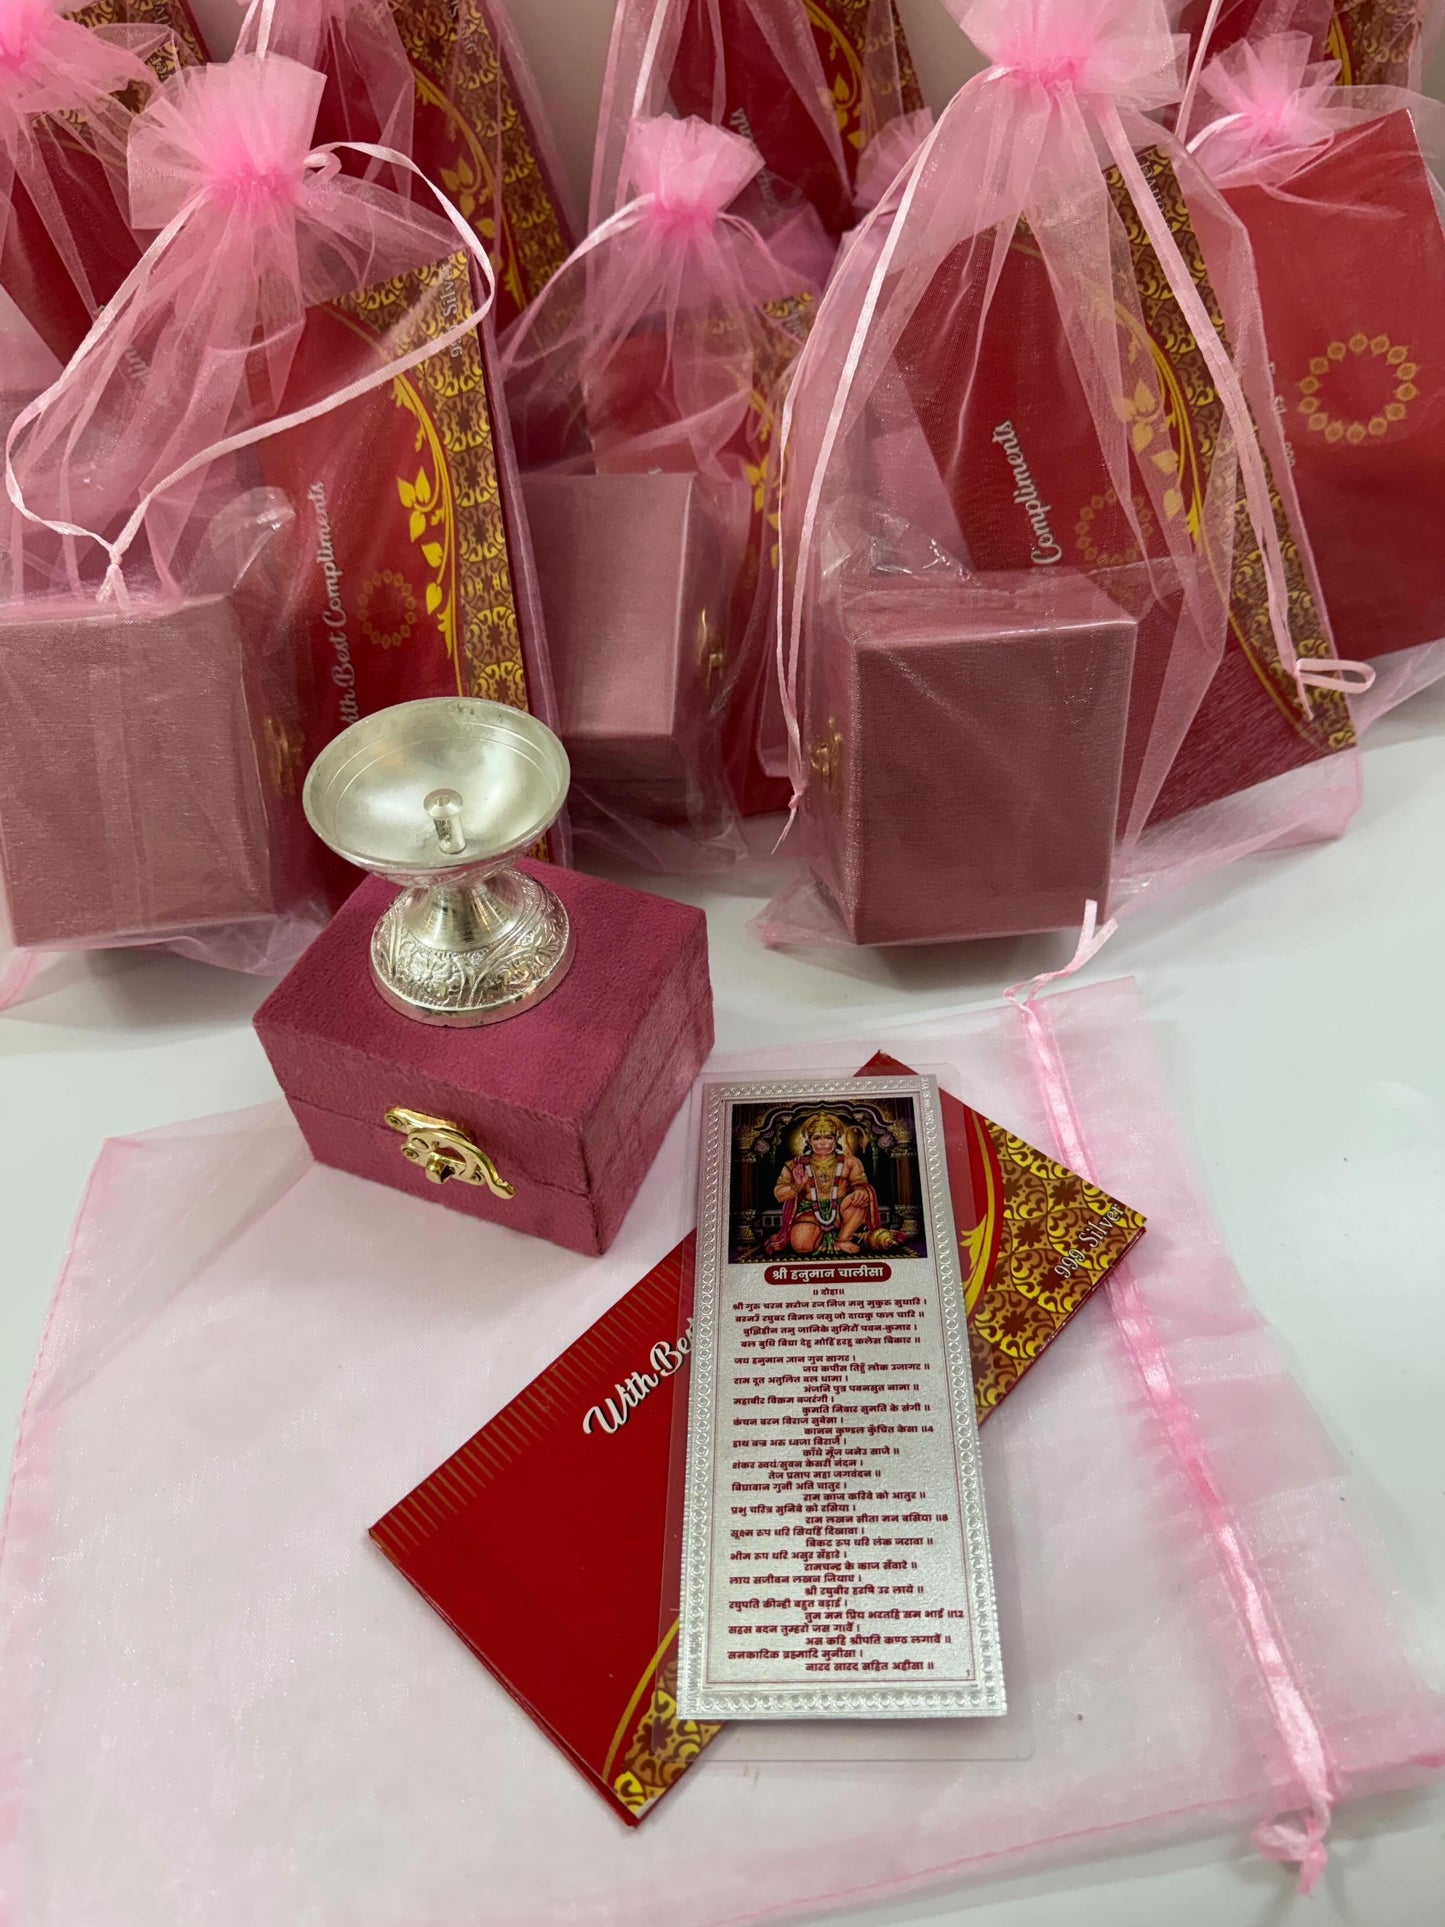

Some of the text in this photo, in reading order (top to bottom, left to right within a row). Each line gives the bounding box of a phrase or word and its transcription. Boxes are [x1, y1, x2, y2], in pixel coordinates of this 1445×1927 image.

[991, 420, 1062, 565] Compliments
[307, 481, 347, 628] Compliments
[332, 632, 355, 687] Best
[772, 1265, 884, 1282] श्री हनुमान चालीसा
[1054, 1203, 1125, 1279] 999 Silver
[582, 1371, 660, 1435] With
